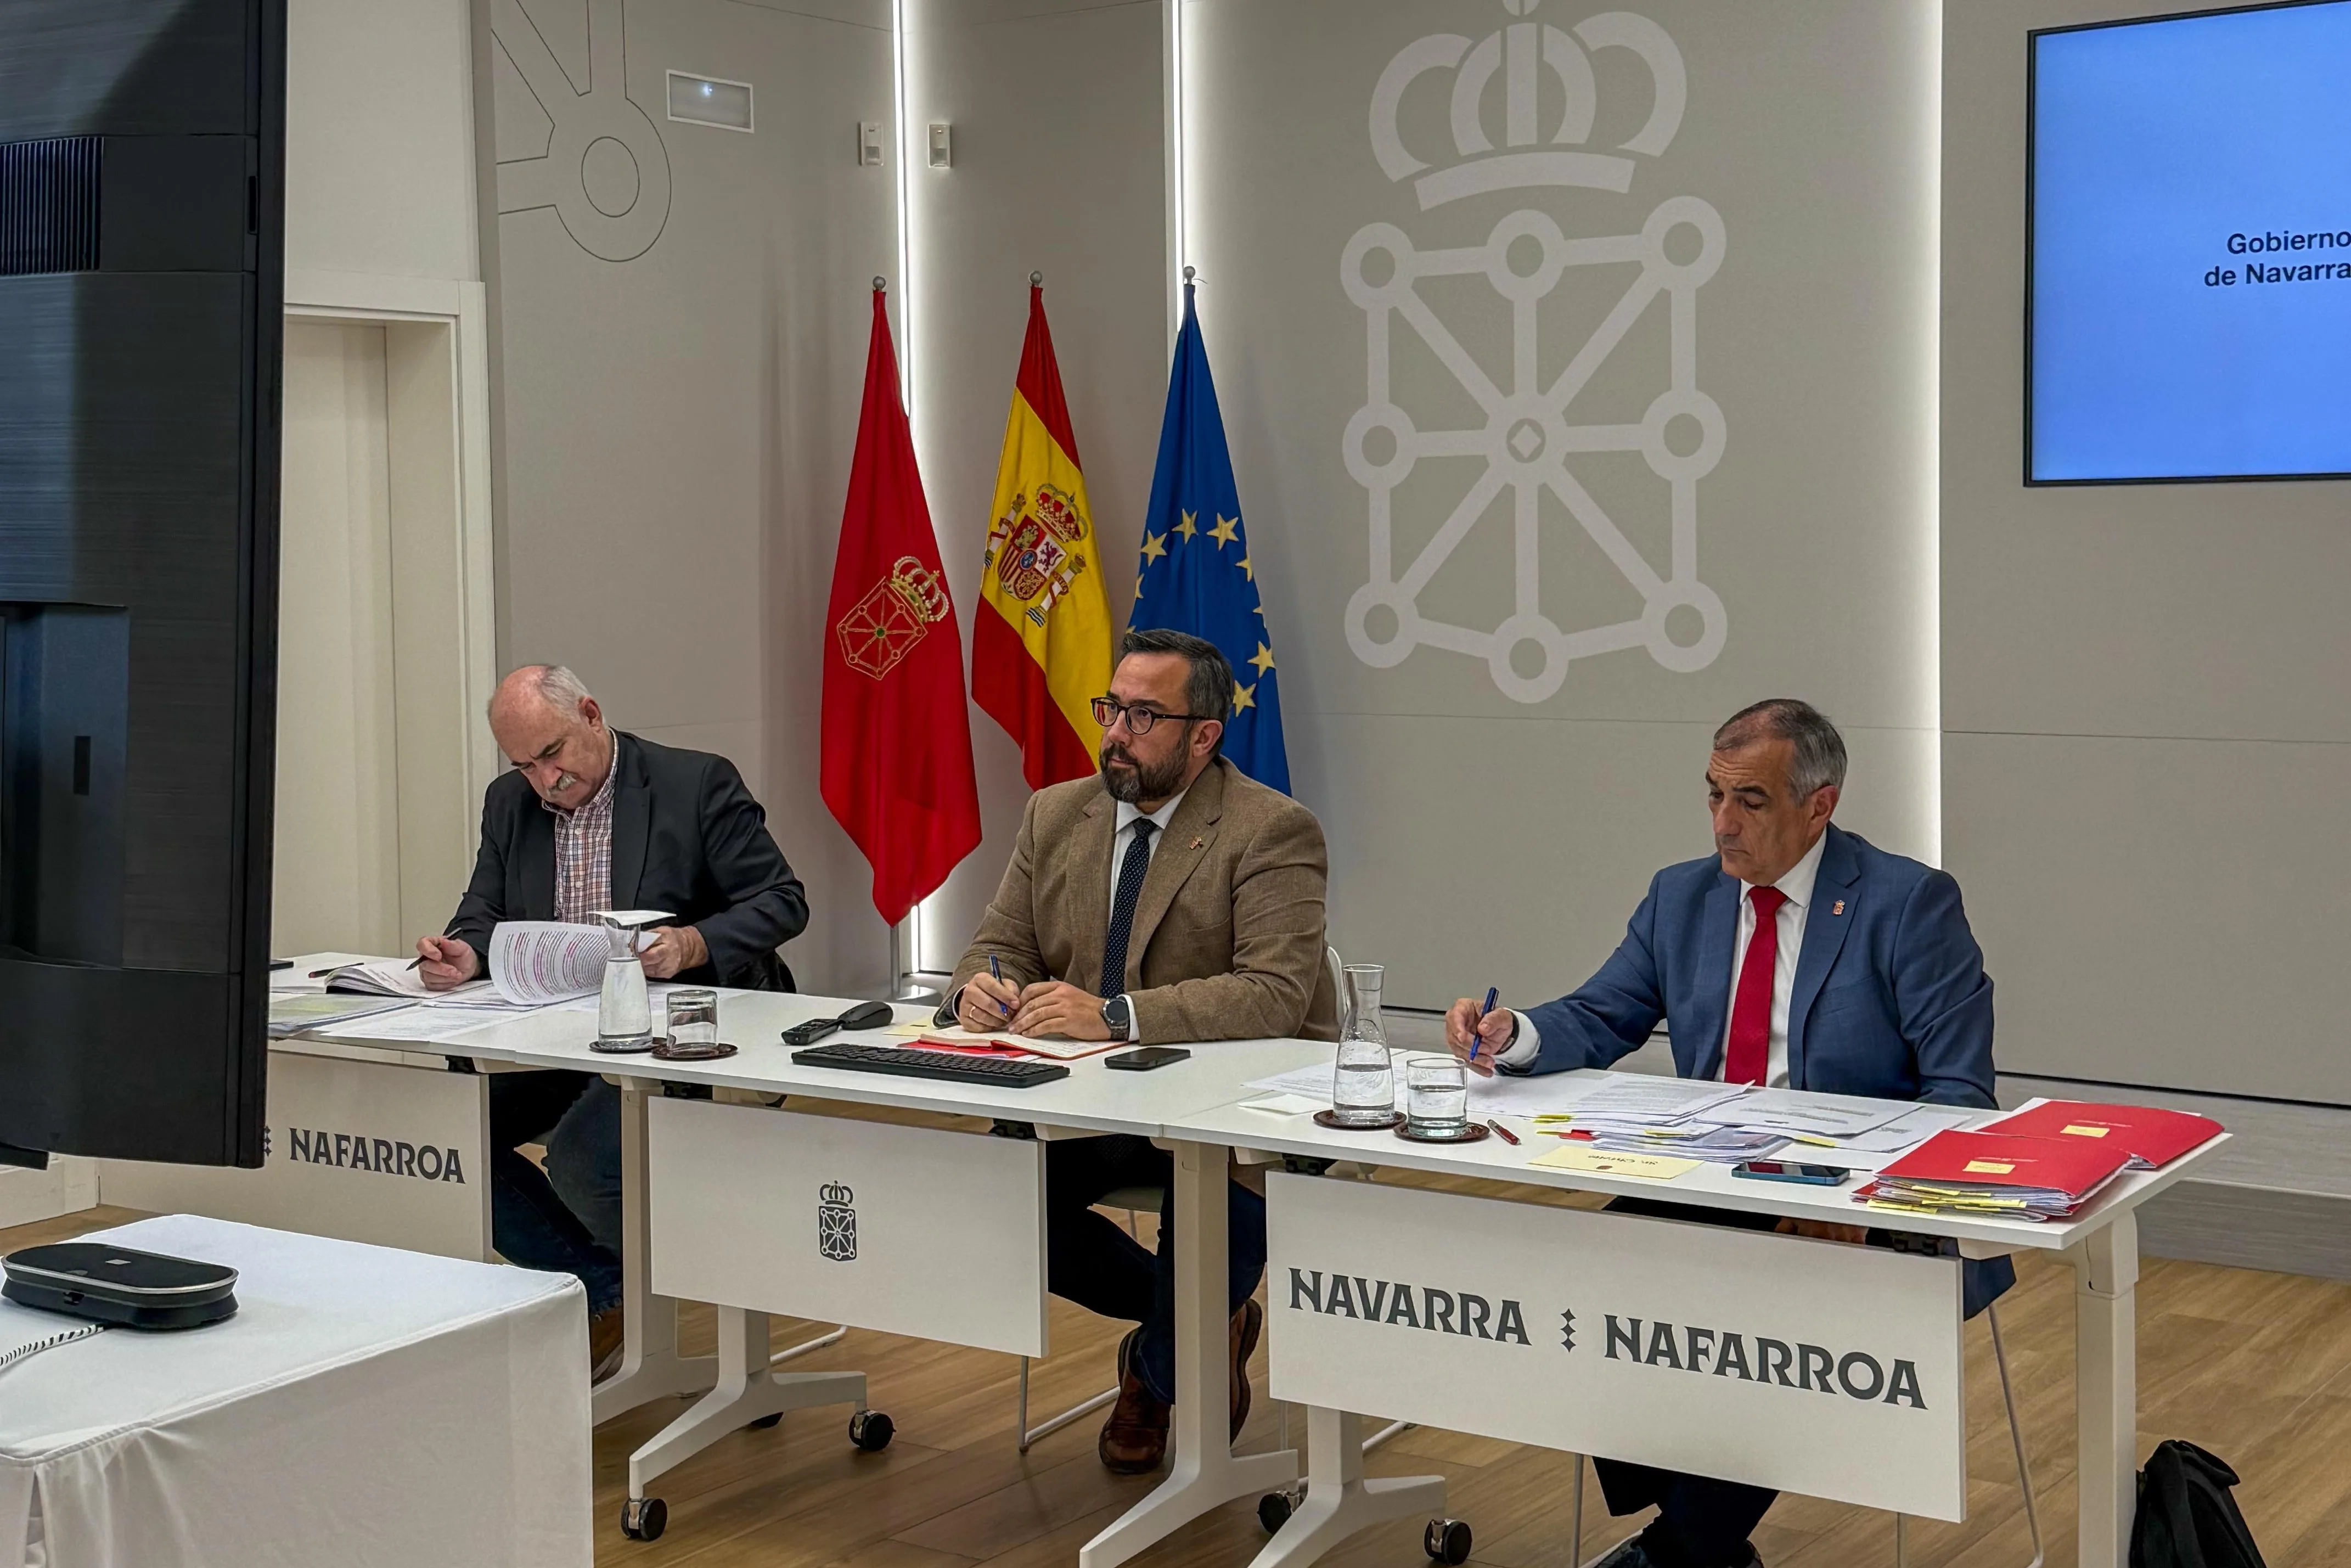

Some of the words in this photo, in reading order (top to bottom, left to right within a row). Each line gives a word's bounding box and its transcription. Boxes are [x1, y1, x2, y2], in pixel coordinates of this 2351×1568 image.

[2227, 231, 2351, 254] Gobierno
[2204, 266, 2236, 286] de
[2246, 262, 2351, 284] Navarra
[289, 1127, 466, 1184] NAFARROA
[1288, 1267, 1532, 1346] NAVARRA
[1604, 1314, 1928, 1410] NAFARROA
